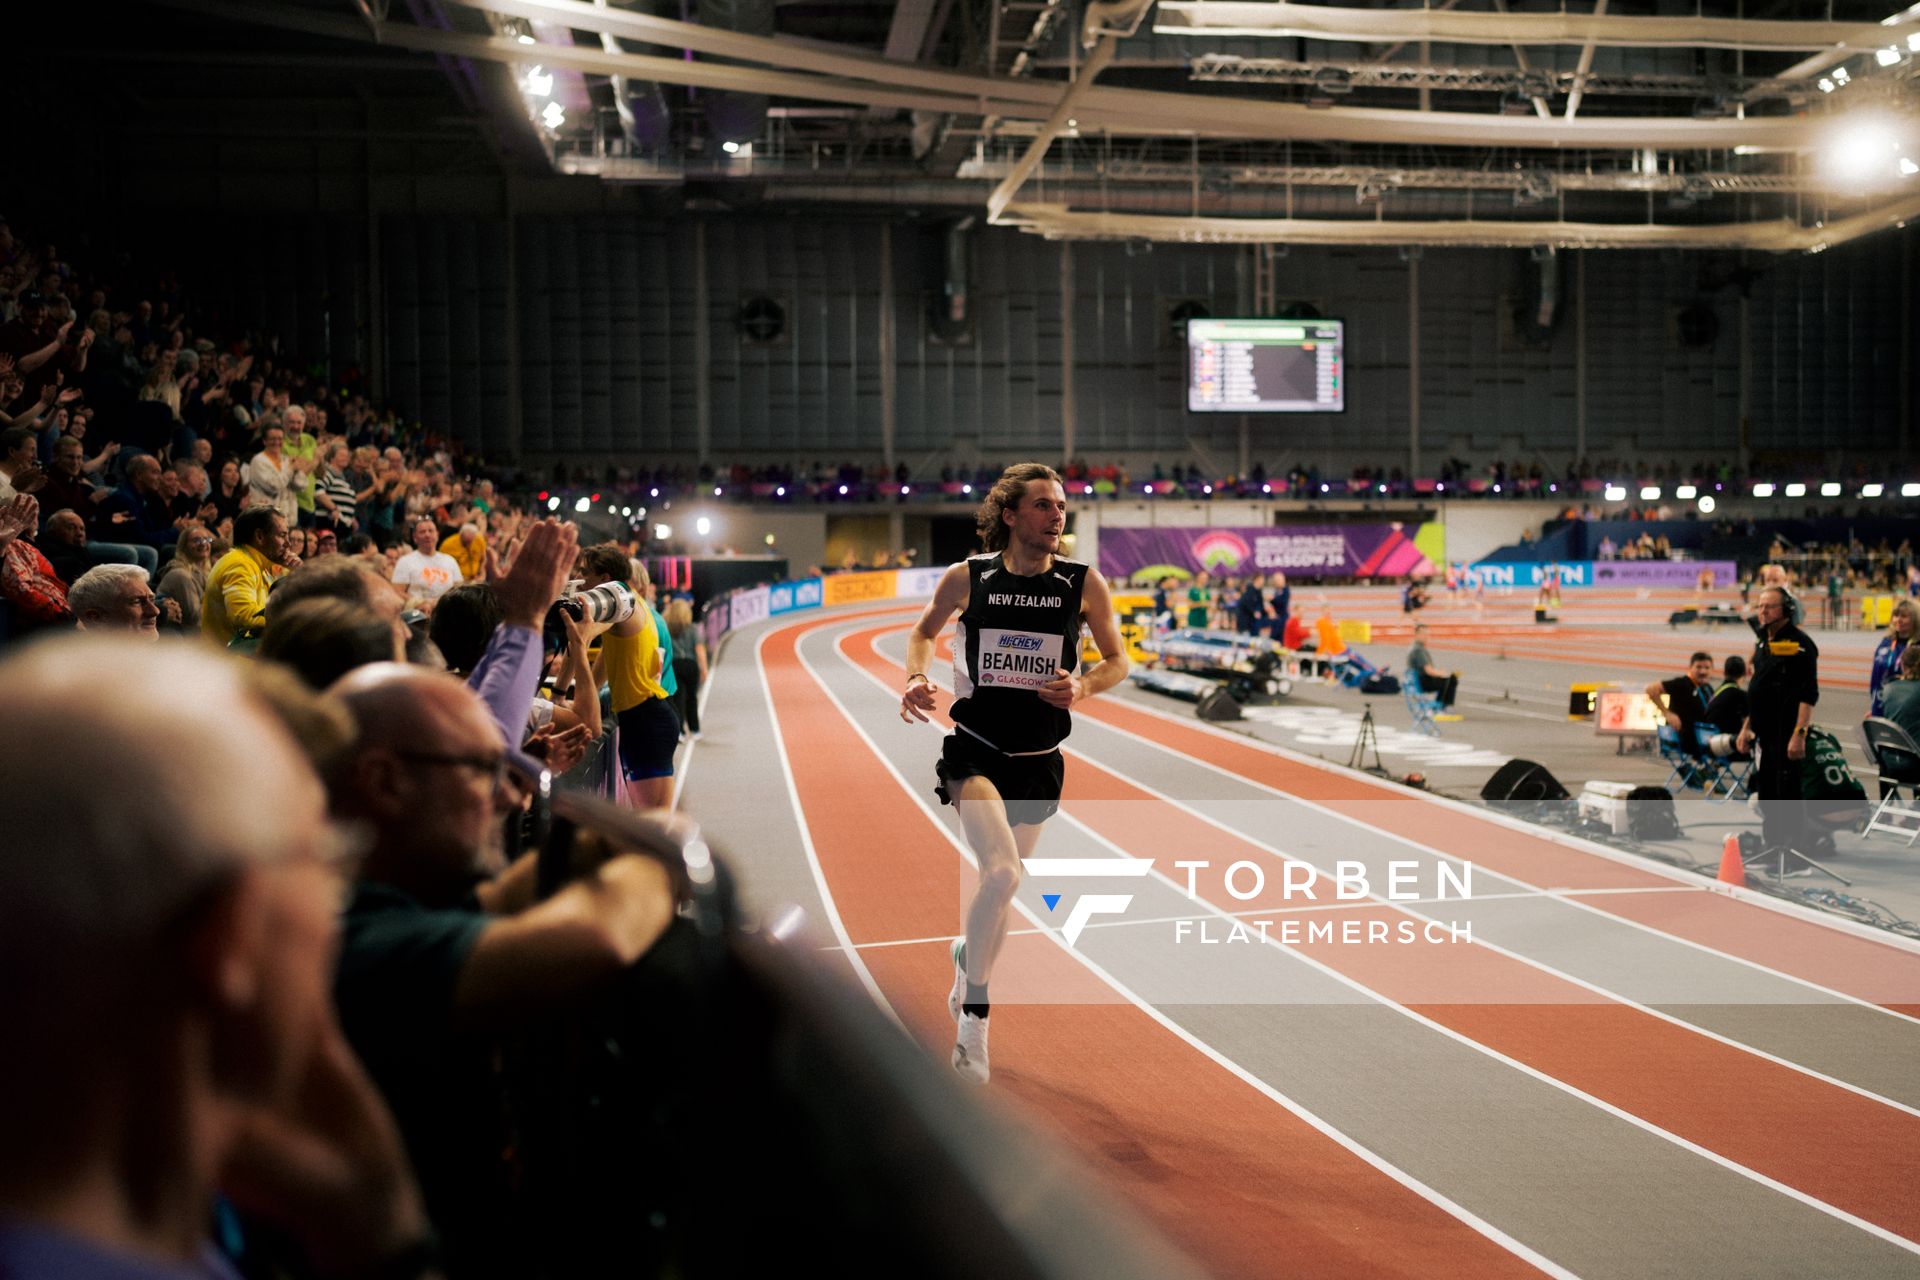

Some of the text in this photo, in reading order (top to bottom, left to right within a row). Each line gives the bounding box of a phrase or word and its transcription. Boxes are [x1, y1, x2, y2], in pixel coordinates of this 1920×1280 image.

[988, 593, 1062, 608] NEW ZEALAND
[998, 634, 1044, 652] HI-CHEW
[983, 652, 1056, 676] BEAMISH
[997, 675, 1045, 686] GLASGOW
